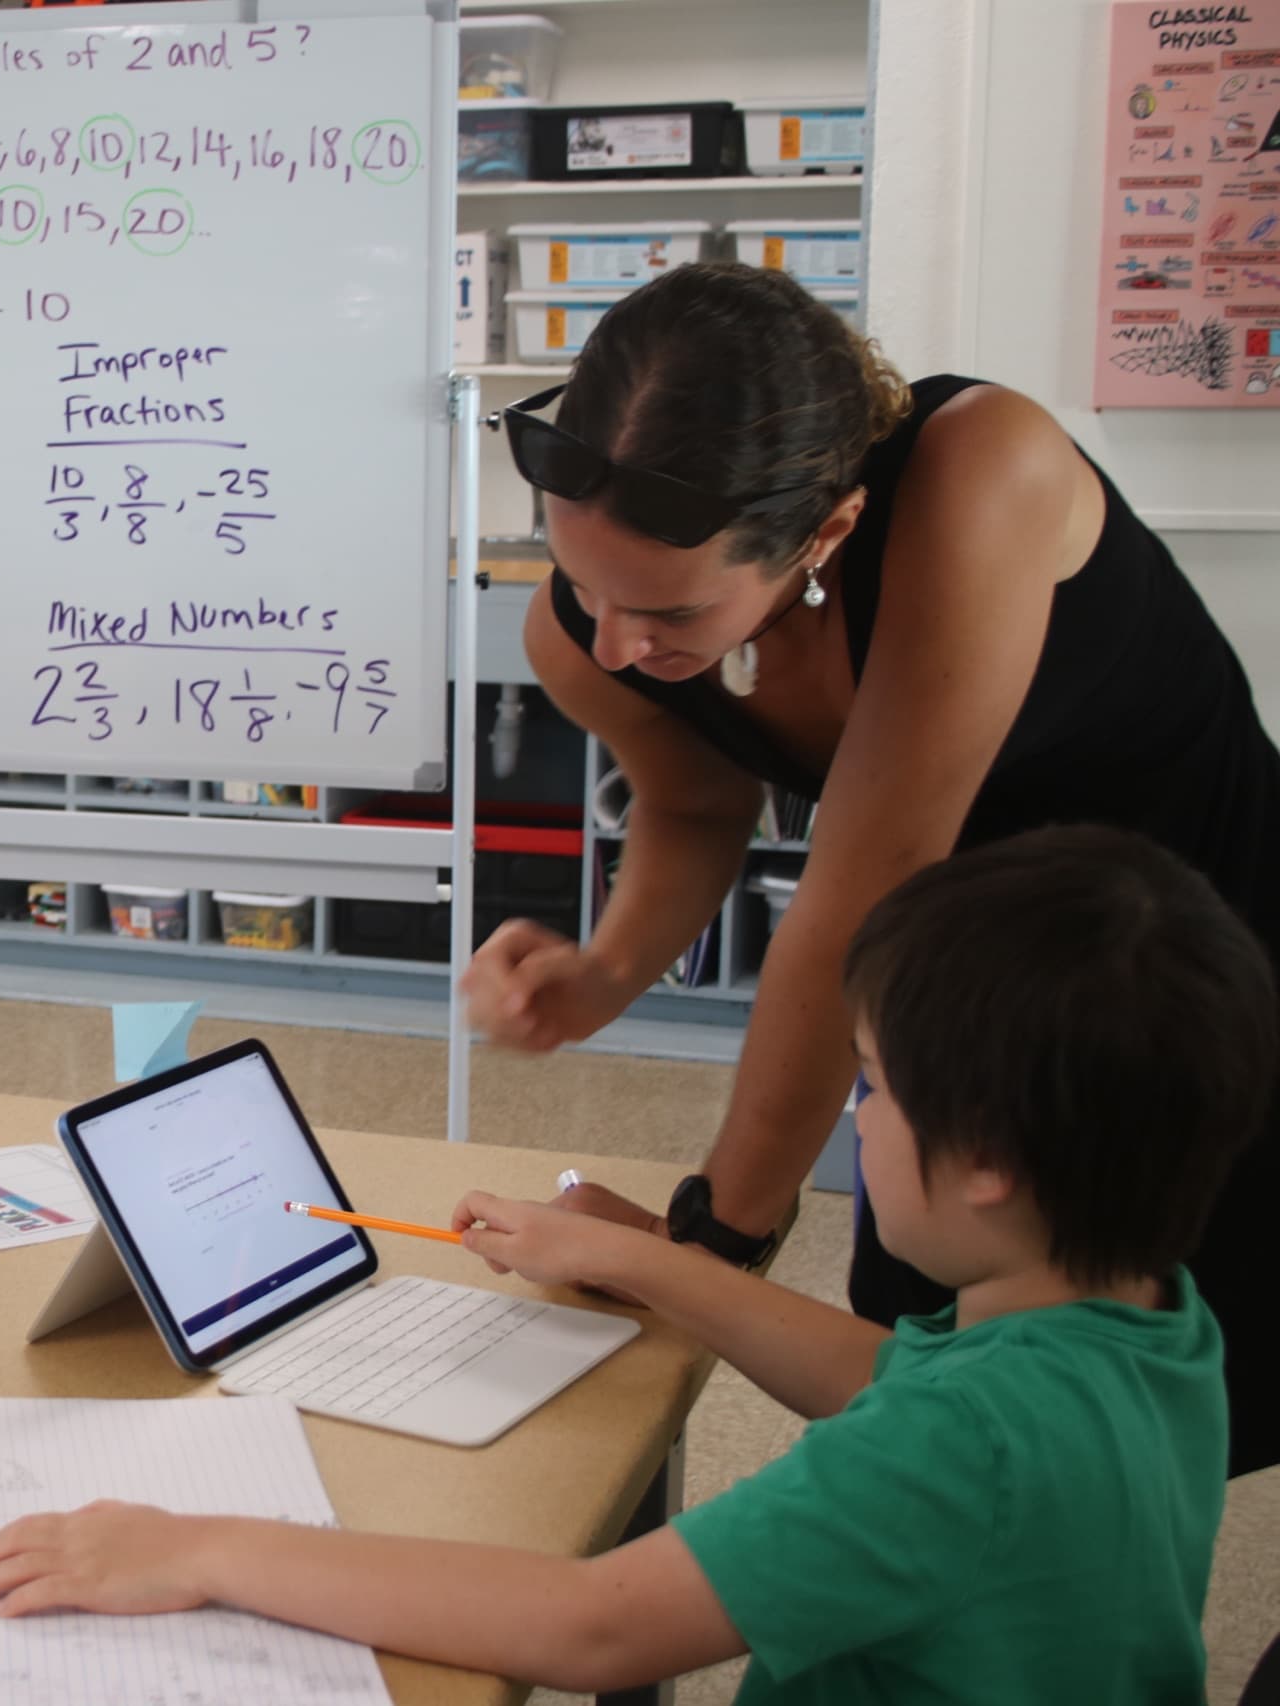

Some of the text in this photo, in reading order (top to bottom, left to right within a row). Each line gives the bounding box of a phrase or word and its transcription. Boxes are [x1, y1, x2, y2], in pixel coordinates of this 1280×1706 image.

[1149, 6, 1253, 29] CLASSICAL
[66, 33, 106, 70] of
[125, 36, 153, 71] 2
[168, 30, 231, 70] and
[1159, 27, 1238, 50] PHYSICS
[57, 343, 228, 384] Improper
[64, 394, 226, 434] Fractions
[170, 597, 339, 636] Numbers
